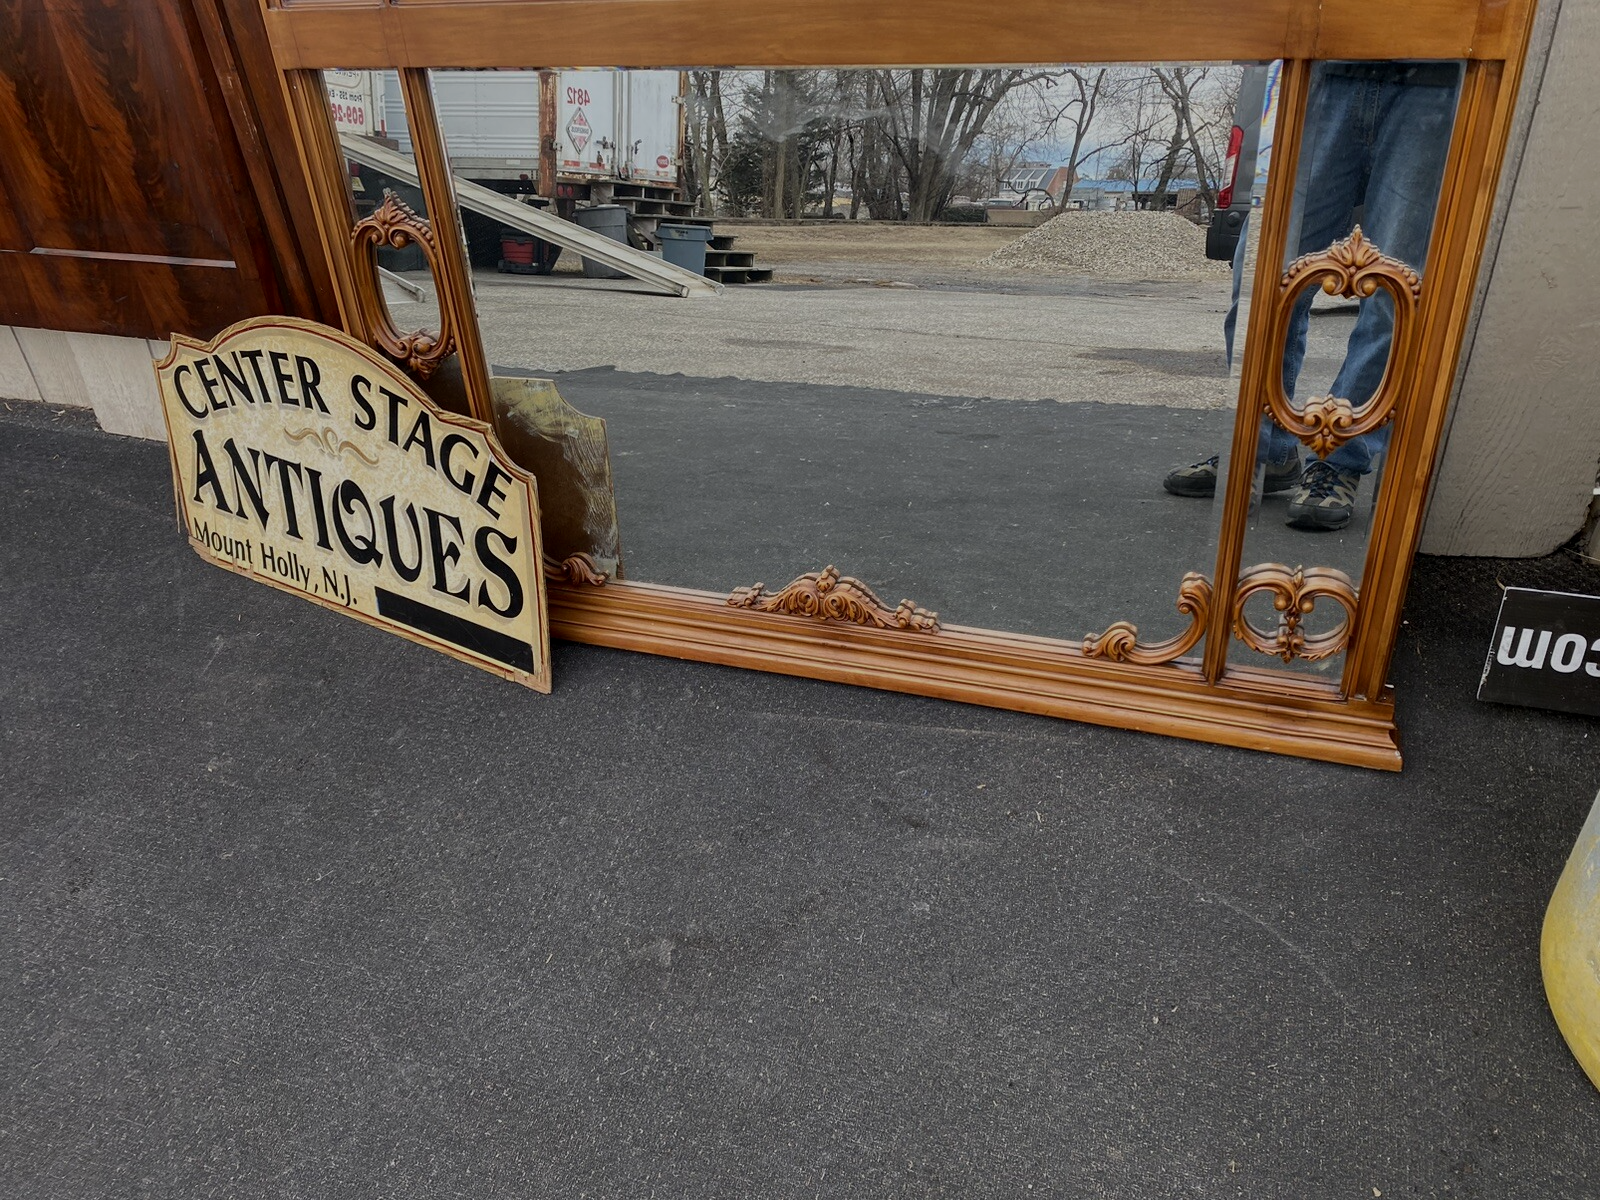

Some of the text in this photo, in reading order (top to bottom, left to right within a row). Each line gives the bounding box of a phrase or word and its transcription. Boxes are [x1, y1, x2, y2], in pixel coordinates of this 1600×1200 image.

[173, 349, 513, 519] CENTER STAGE
[193, 429, 524, 618] ANTIQUES
[193, 516, 358, 606] Mount Holly, N.J.
